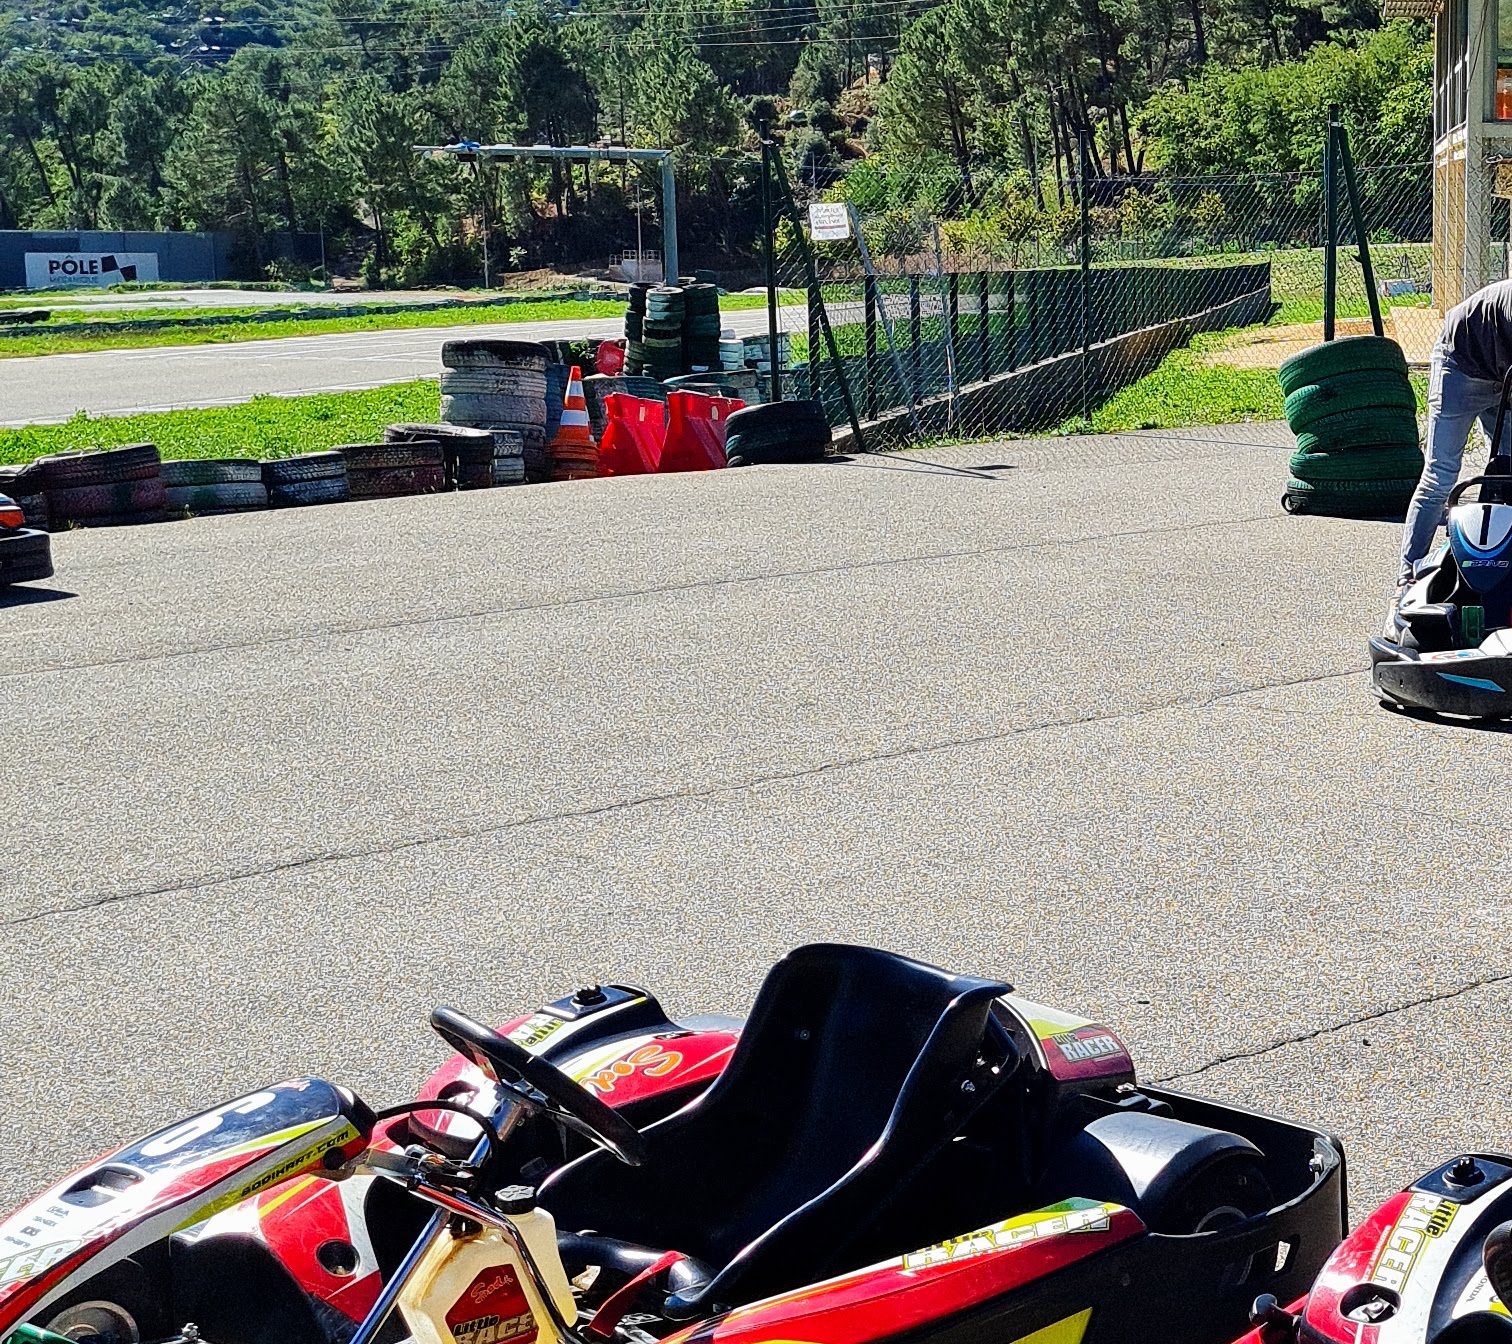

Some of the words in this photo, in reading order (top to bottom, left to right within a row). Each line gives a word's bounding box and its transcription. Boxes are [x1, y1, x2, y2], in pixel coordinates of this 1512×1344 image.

[48, 255, 99, 275] PÔLE
[1478, 504, 1493, 546] 1
[1061, 1035, 1122, 1061] RACER
[903, 1206, 1111, 1271] RACER
[1372, 1192, 1443, 1293] RACER
